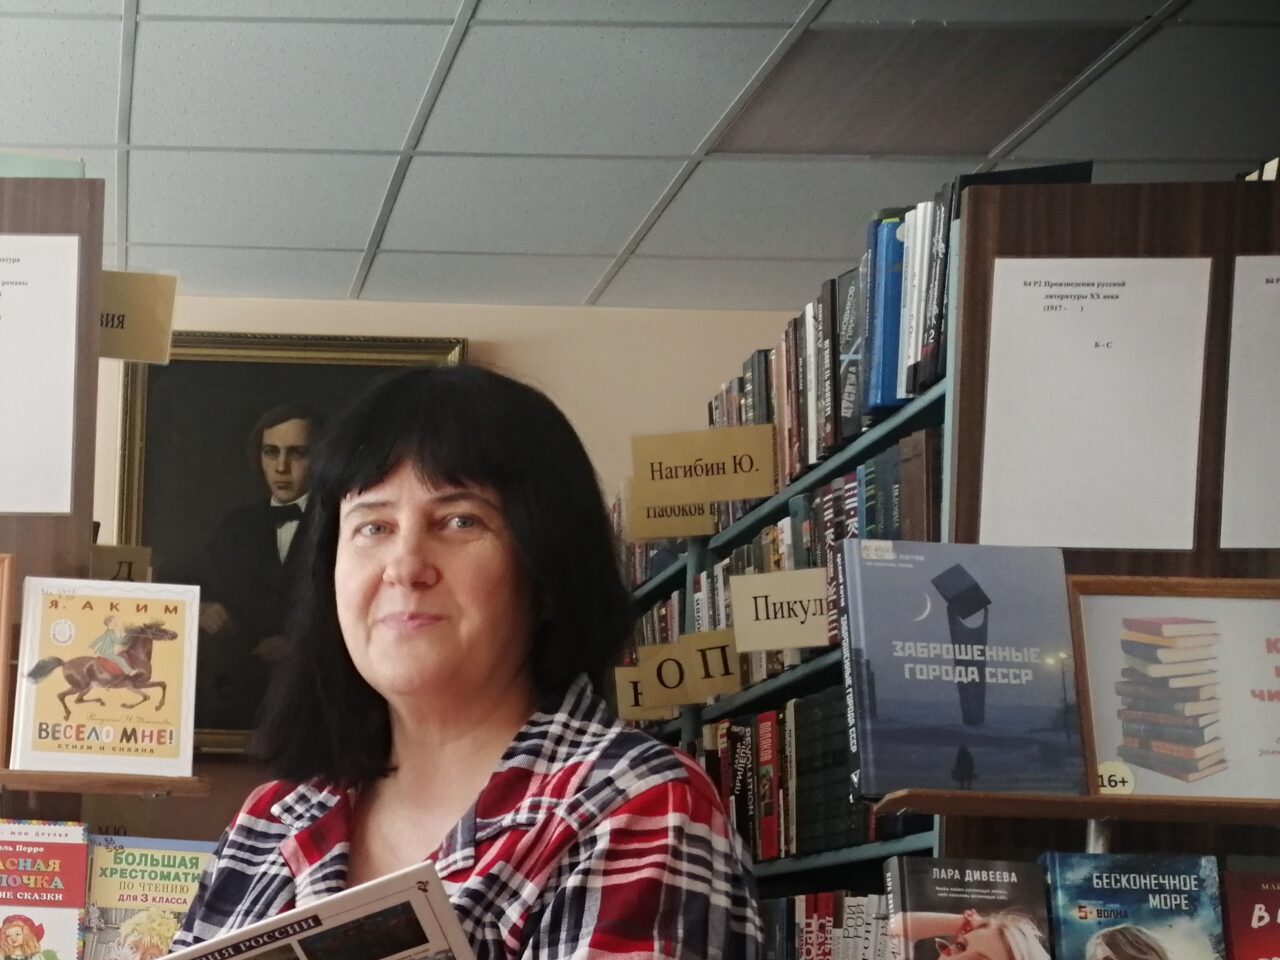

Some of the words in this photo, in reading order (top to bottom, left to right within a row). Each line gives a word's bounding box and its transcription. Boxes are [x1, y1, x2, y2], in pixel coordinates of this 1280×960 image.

[841, 365, 858, 418] ЦУСИМА
[650, 458, 727, 481] Нагибин
[732, 454, 759, 474] Ю.
[49, 600, 67, 609] Я.
[840, 614, 853, 687] ЗАБРОШЕННЫЕ
[892, 640, 1041, 664] ЗАБРОШЕННЫЕ
[696, 645, 735, 679] П
[656, 658, 685, 689] О
[904, 663, 980, 684] ГОРОДА
[985, 666, 1034, 685] СССР
[845, 688, 856, 727] ГОРОДА
[38, 722, 114, 742] ВЕСЕЛО
[120, 727, 173, 745] МНЕ!
[848, 727, 858, 753] СССР
[1098, 773, 1129, 789] 16+
[16, 844, 45, 854] Перро
[113, 852, 200, 870] БОЛЬШАЯ
[99, 868, 202, 884] ХРЕСТОМАТИ
[932, 868, 960, 881] ЛАРА
[964, 869, 1018, 884] ДИВЕЕВА
[1092, 871, 1199, 892] БЕСКОНЕЧНОЕ
[17, 892, 63, 901] СКАЗКИ
[119, 882, 135, 891] ПО
[139, 882, 190, 894] ЧТЕНИЮ
[118, 893, 138, 902] ДЛЯ
[140, 893, 149, 903] 3
[152, 896, 188, 906] КЛАССА
[1148, 893, 1190, 911] МОРЕ
[1096, 907, 1129, 920] ВОЛНА
[240, 916, 316, 952] РОССИИ
